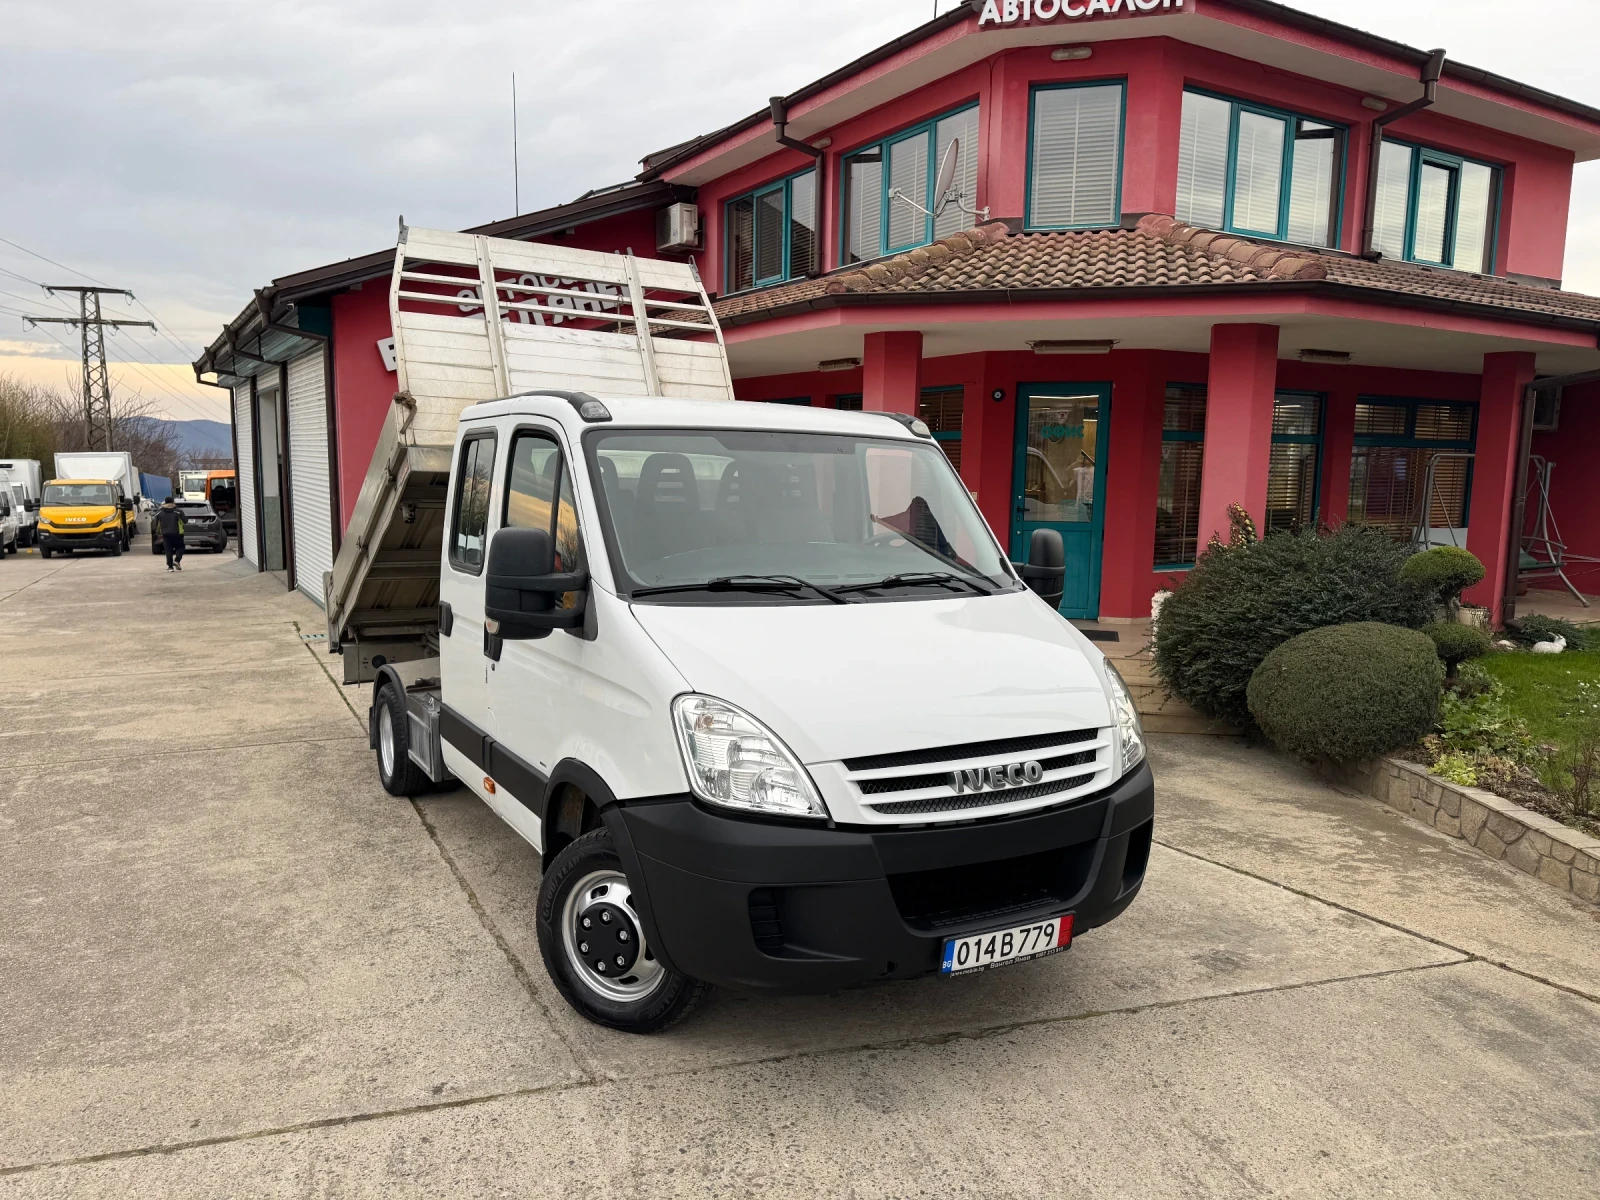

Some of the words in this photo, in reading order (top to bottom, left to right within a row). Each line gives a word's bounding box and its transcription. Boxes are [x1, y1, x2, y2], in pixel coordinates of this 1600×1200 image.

[1041, 424, 1085, 439] ОФИС
[951, 760, 1043, 794] IVECO
[942, 961, 952, 969] BG
[957, 922, 1055, 966] 014B779
